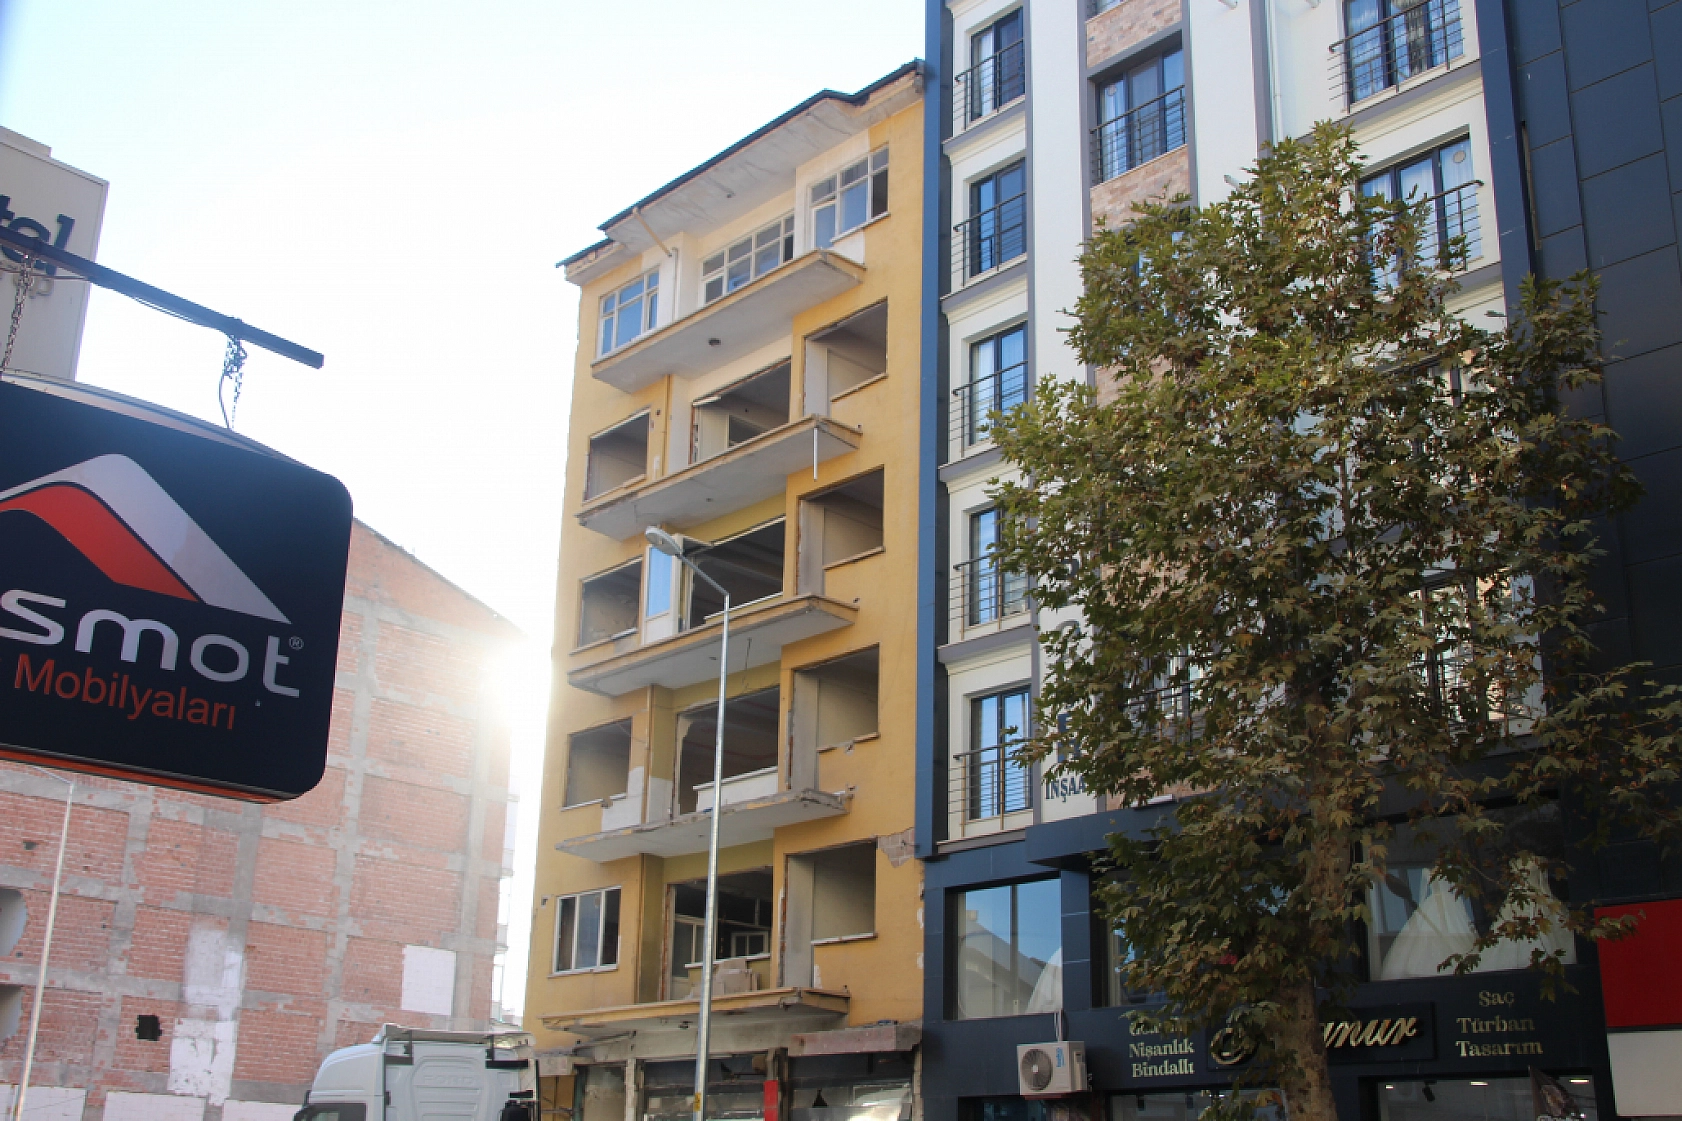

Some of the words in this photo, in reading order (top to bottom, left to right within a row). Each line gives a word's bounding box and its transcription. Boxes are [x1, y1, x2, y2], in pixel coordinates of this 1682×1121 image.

[0, 589, 300, 698] smot
[14, 653, 236, 730] Mobilyaları
[1478, 989, 1515, 1008] Saç
[1456, 1015, 1536, 1034] Türban
[1129, 1038, 1195, 1061] Nişanlık
[1454, 1040, 1544, 1058] Tasarım
[1131, 1058, 1195, 1078] Bindallı
